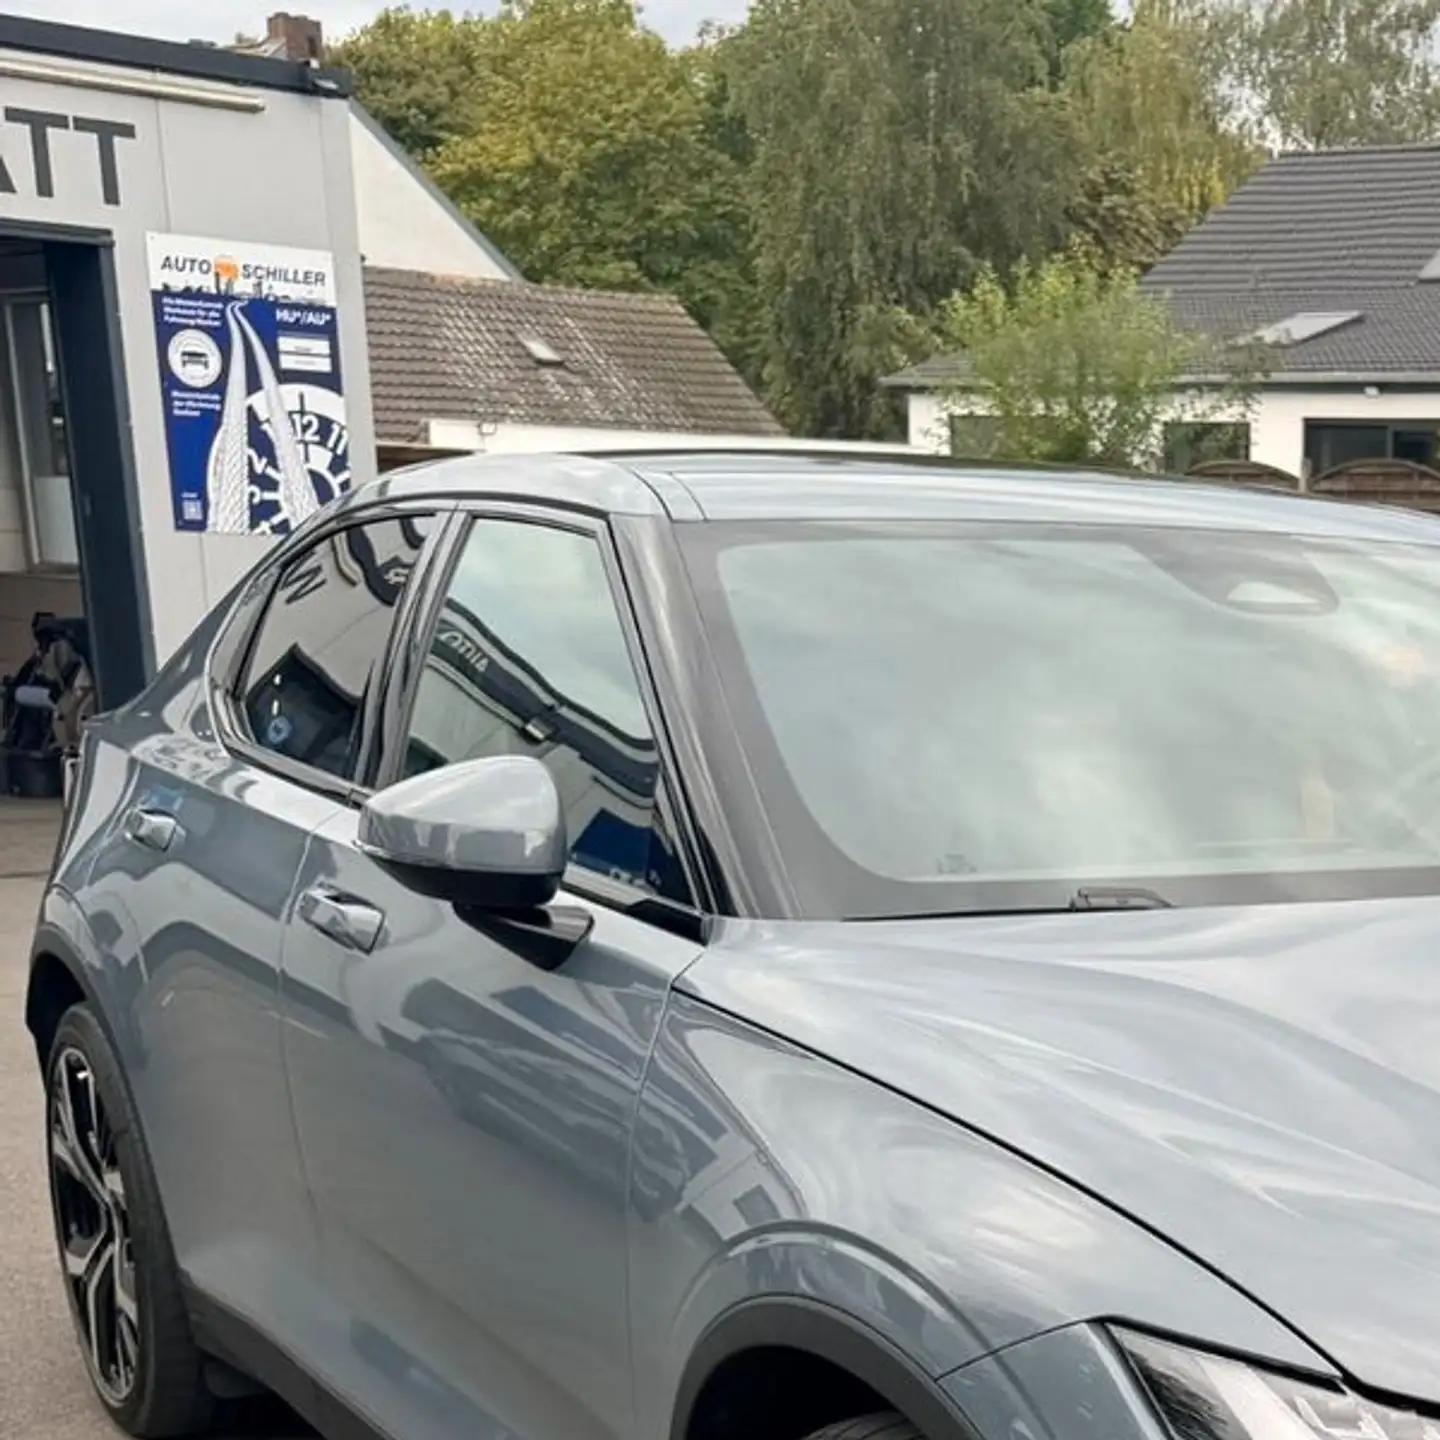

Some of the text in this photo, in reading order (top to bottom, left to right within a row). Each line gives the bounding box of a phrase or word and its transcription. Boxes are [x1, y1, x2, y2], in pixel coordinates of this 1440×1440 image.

[161, 255, 326, 286] AUTO SCHILLER
[292, 414, 320, 441] 12
